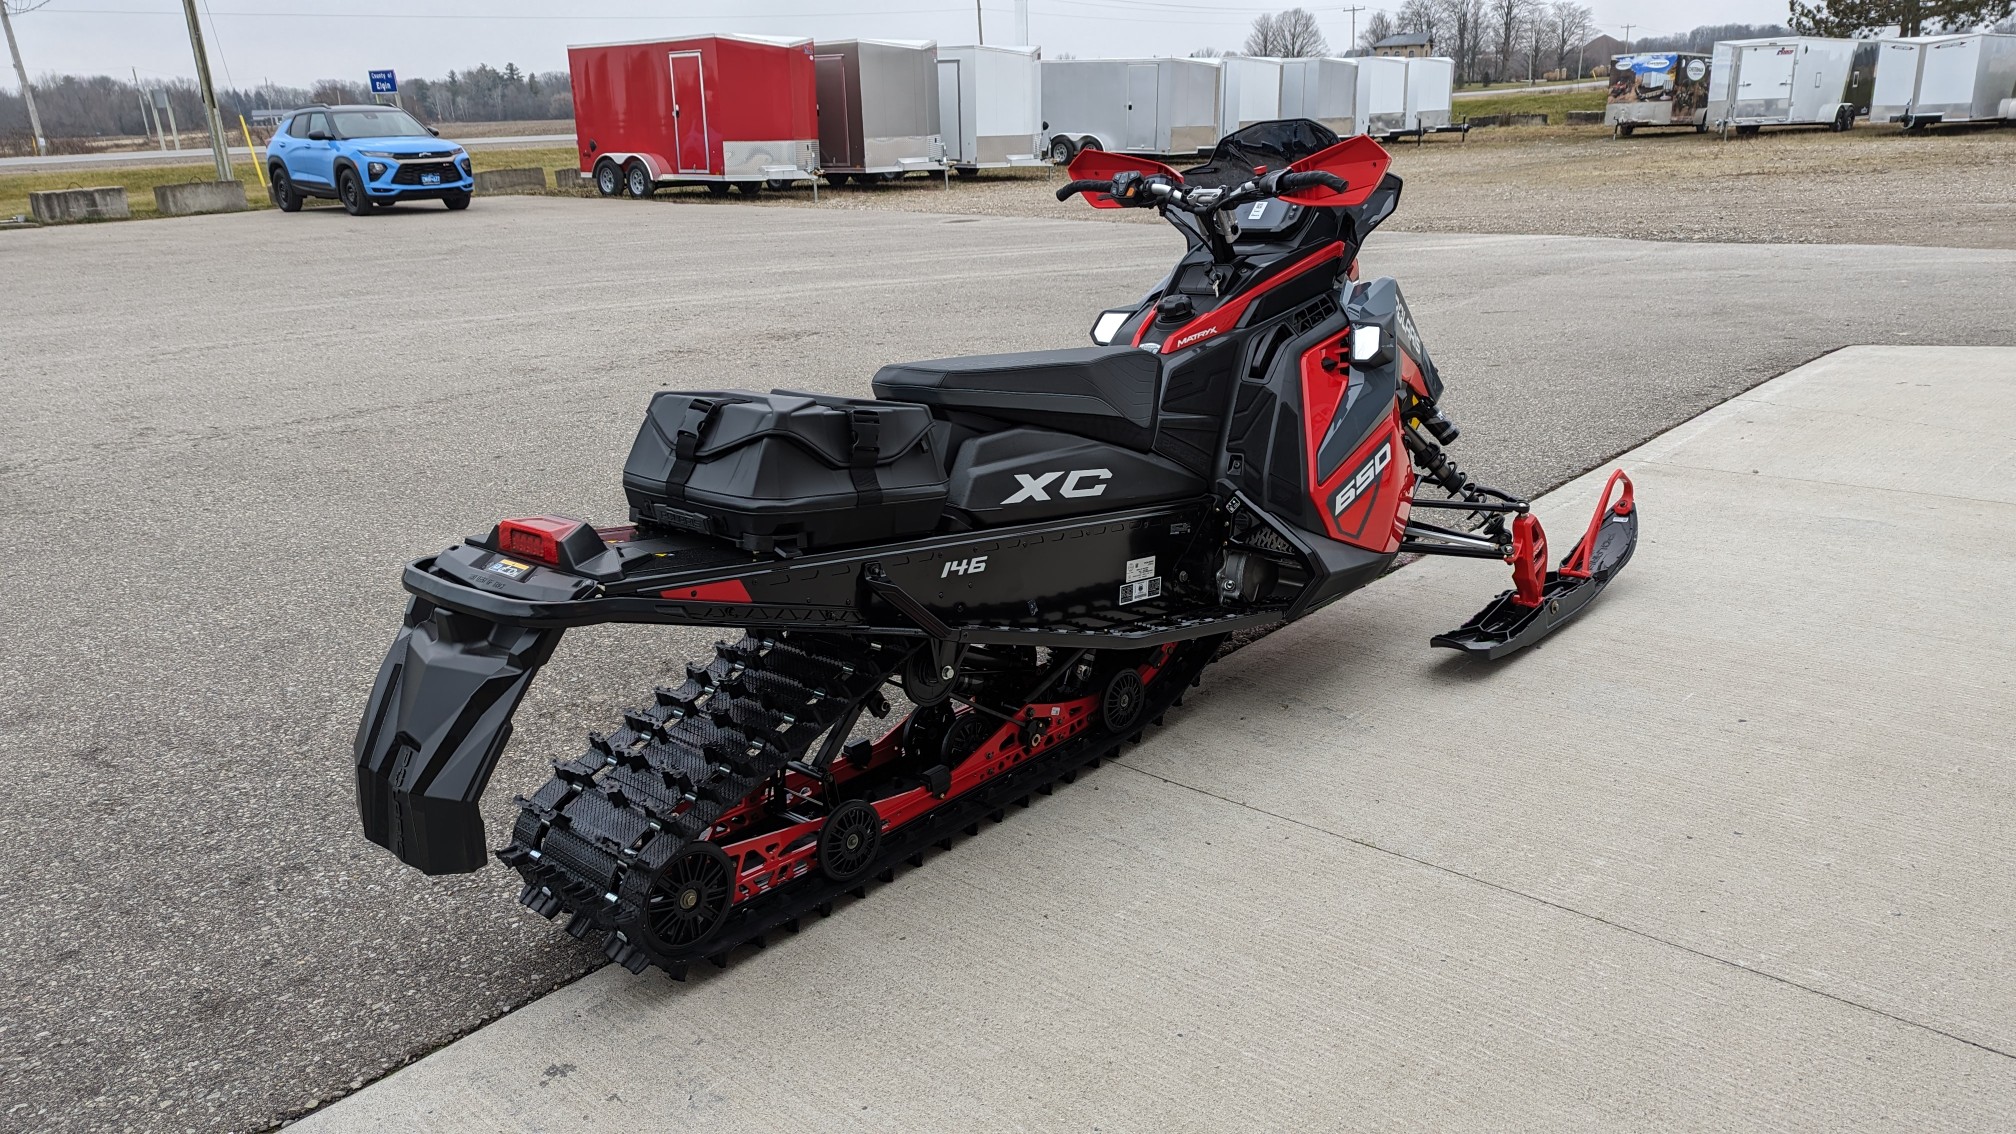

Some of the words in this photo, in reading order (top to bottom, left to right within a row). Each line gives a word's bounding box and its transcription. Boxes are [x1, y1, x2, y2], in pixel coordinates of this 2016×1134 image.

[376, 81, 392, 91] Elgin
[1177, 325, 1217, 348] MATRYX
[1000, 468, 1113, 505] XC
[1335, 442, 1392, 517] 650
[940, 555, 988, 579] 146
